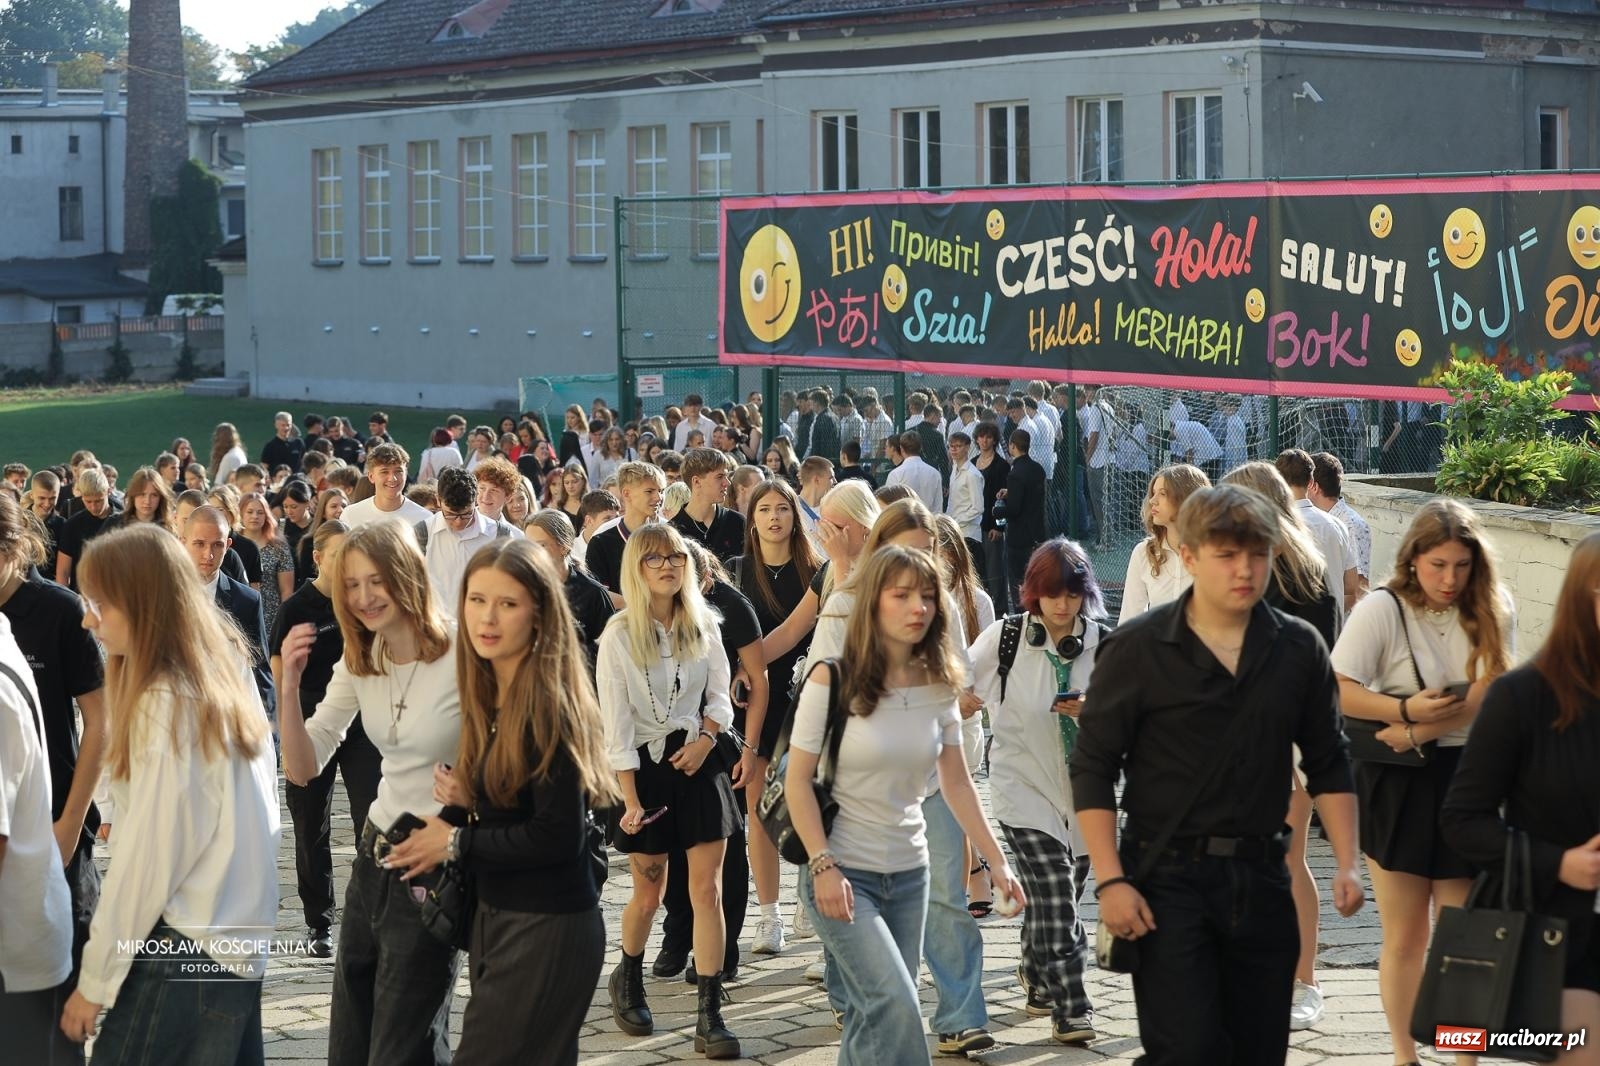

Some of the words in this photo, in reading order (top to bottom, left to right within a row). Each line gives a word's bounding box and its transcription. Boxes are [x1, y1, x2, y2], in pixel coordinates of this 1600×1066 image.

[829, 216, 875, 278] HI!
[889, 219, 980, 277] Привіт!
[996, 214, 1138, 298] CZEŚĆ!
[1150, 215, 1258, 289] Hola!
[1280, 238, 1407, 308] SALUT!
[903, 288, 992, 345] Szia!
[1029, 298, 1102, 355] Hallo!
[1114, 302, 1245, 367] MERHABA!
[1267, 310, 1370, 368] Bok!
